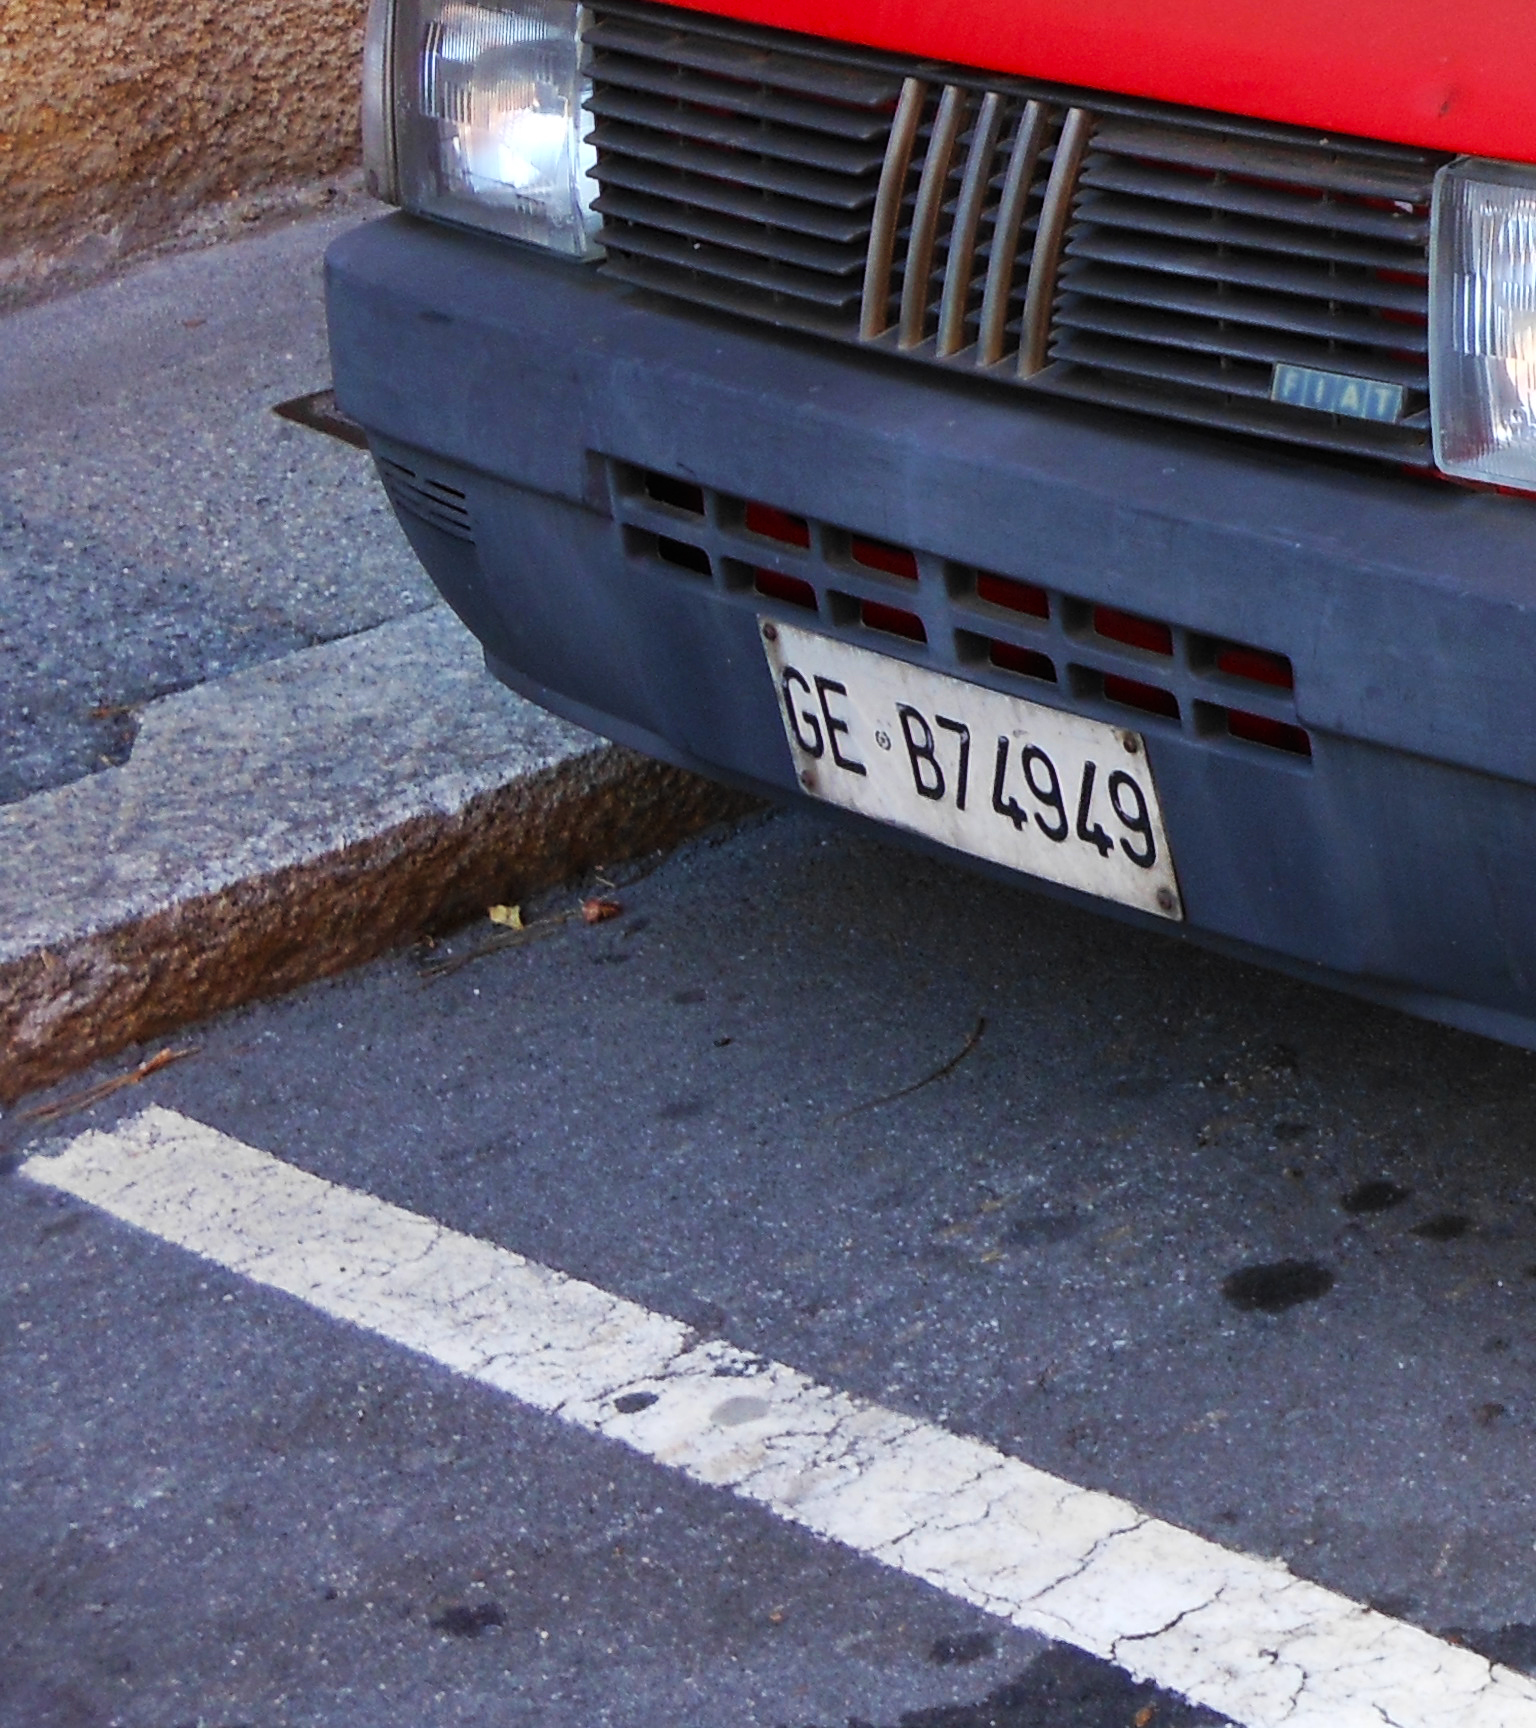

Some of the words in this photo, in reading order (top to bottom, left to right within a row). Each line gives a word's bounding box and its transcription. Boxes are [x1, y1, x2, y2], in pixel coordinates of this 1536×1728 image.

[1281, 369, 1392, 416] FIAT
[781, 665, 867, 777] GE
[895, 701, 1158, 870] B74949
